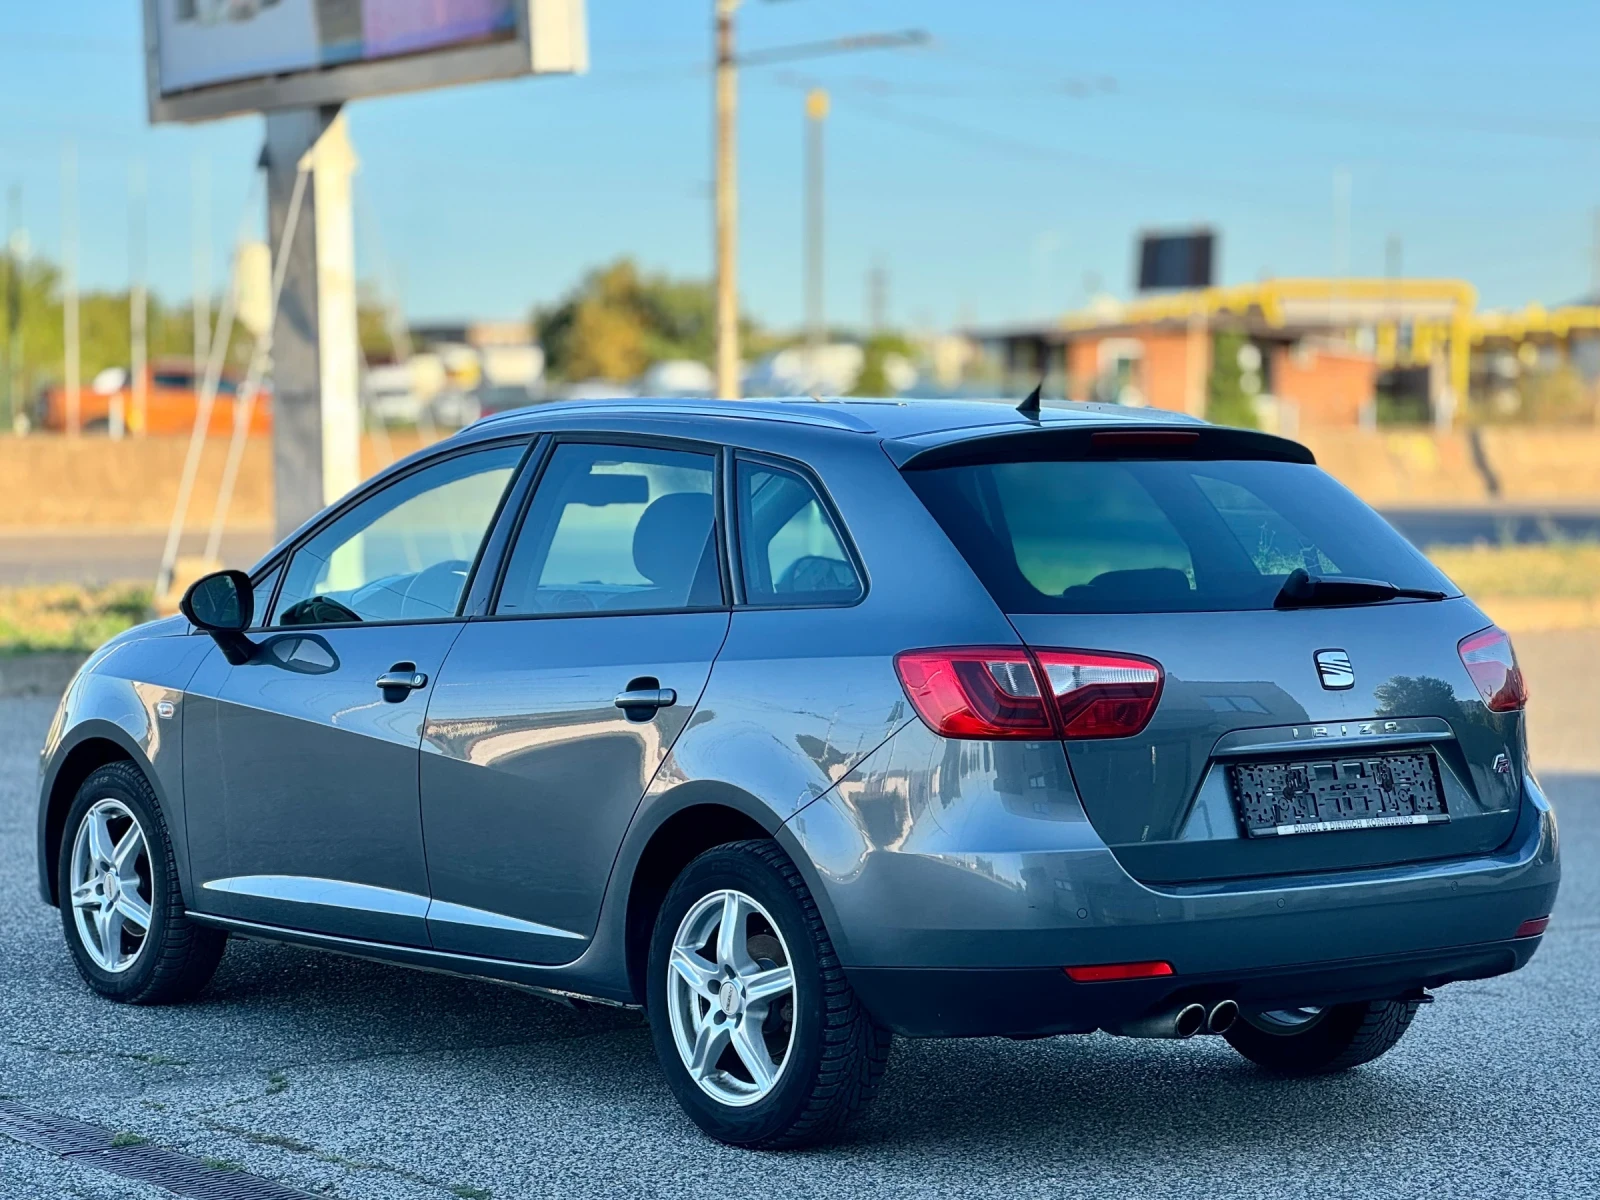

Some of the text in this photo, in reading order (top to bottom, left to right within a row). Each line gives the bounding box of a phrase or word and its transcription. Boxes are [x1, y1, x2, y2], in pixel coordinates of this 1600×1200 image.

[1292, 721, 1397, 739] IBIZA
[1294, 822, 1321, 833] DANGL
[1330, 819, 1363, 831] DIETRICH
[1366, 815, 1414, 828] KORNEUBURG
